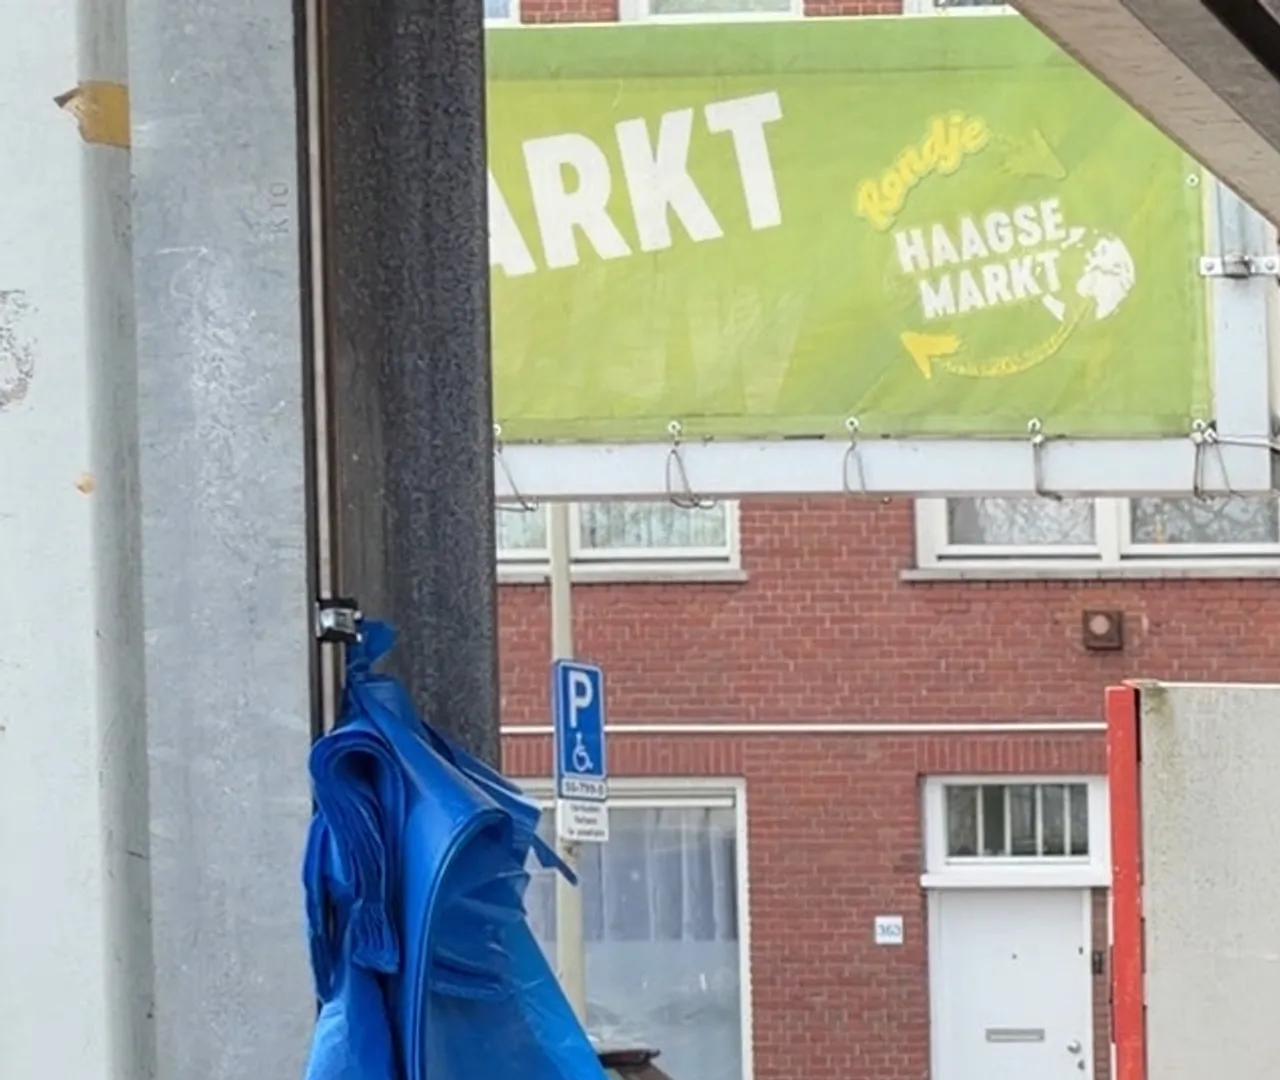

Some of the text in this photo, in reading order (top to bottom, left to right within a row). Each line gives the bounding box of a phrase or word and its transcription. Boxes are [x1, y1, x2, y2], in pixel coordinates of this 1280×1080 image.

[858, 114, 987, 228] Rondje
[895, 198, 1065, 272] HAAGSE
[919, 250, 1061, 318] MARKT
[568, 670, 593, 729] P
